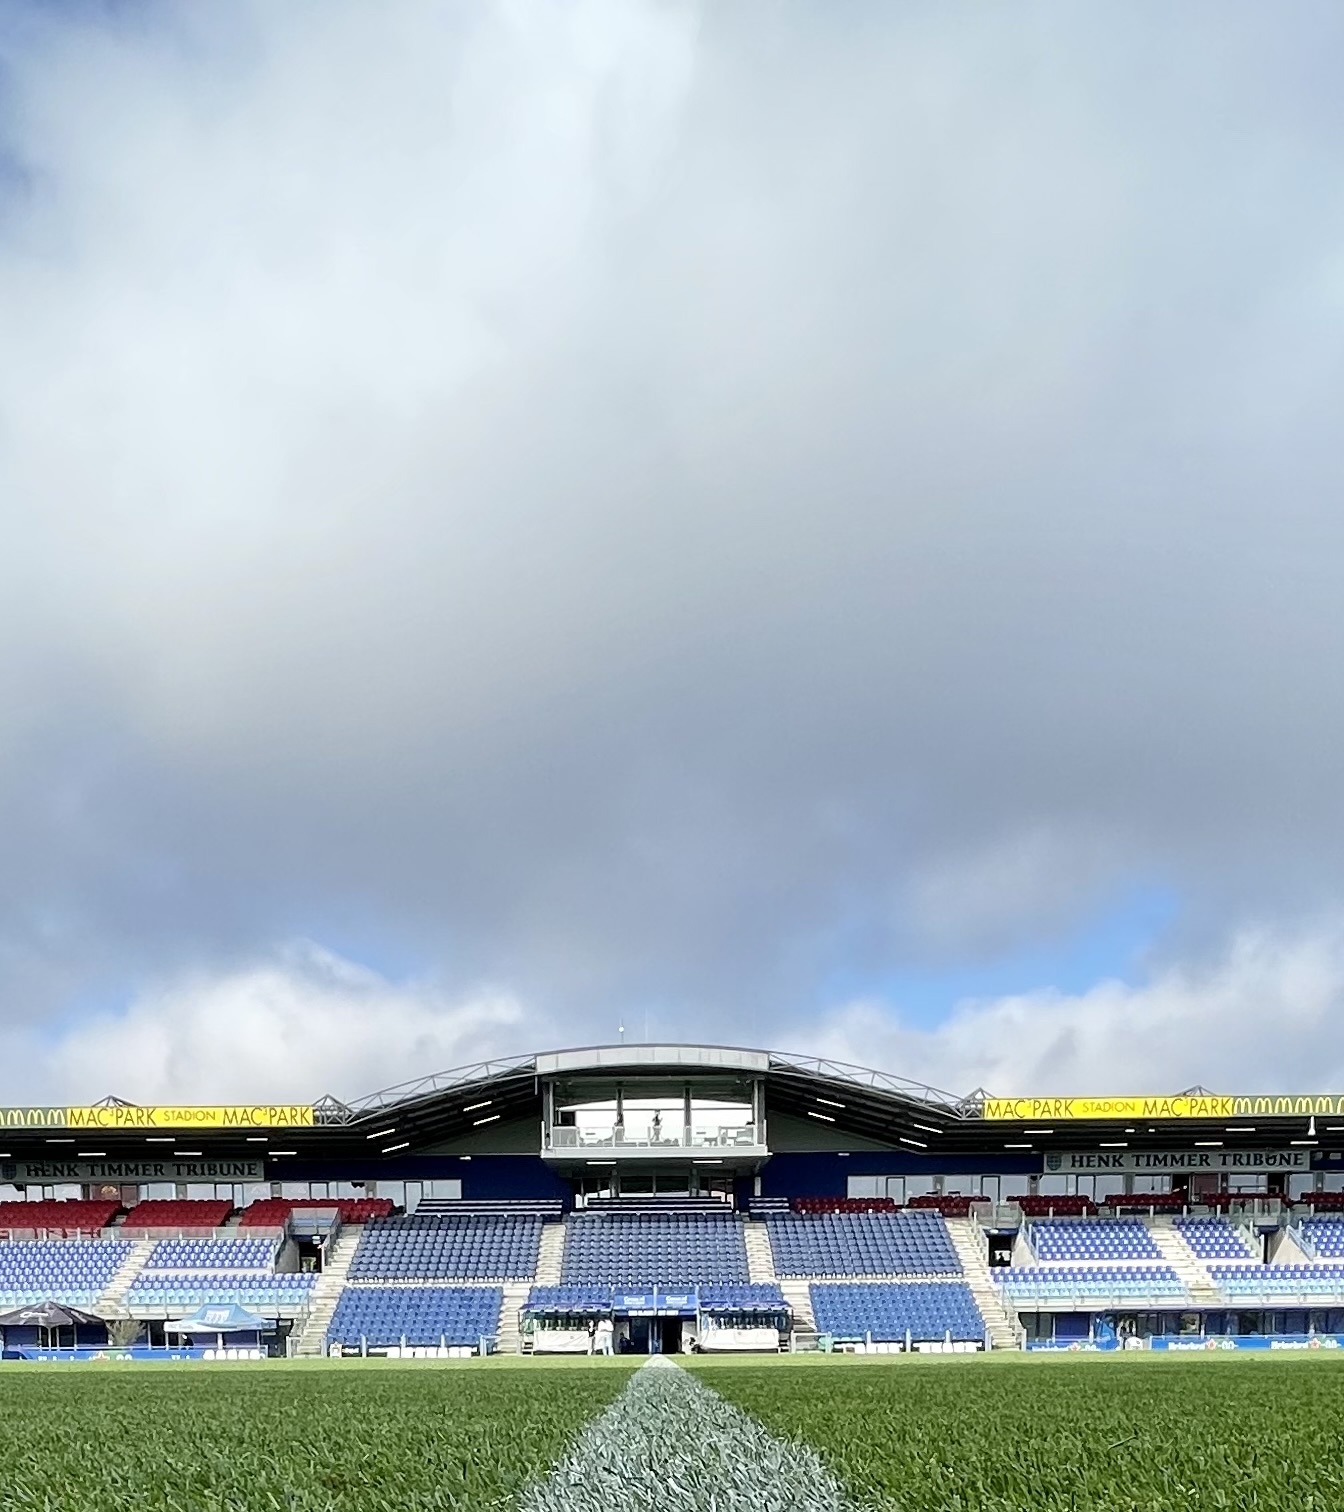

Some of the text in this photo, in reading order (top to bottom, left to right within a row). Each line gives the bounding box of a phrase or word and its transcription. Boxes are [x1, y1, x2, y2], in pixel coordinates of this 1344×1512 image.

[1082, 1101, 1136, 1113] STADION
[163, 1111, 216, 1122] STADION
[1070, 1152, 1304, 1168] HENK TIMMER TRIBUNE
[25, 1162, 258, 1178] HENK TIMMER TRIBUNE
